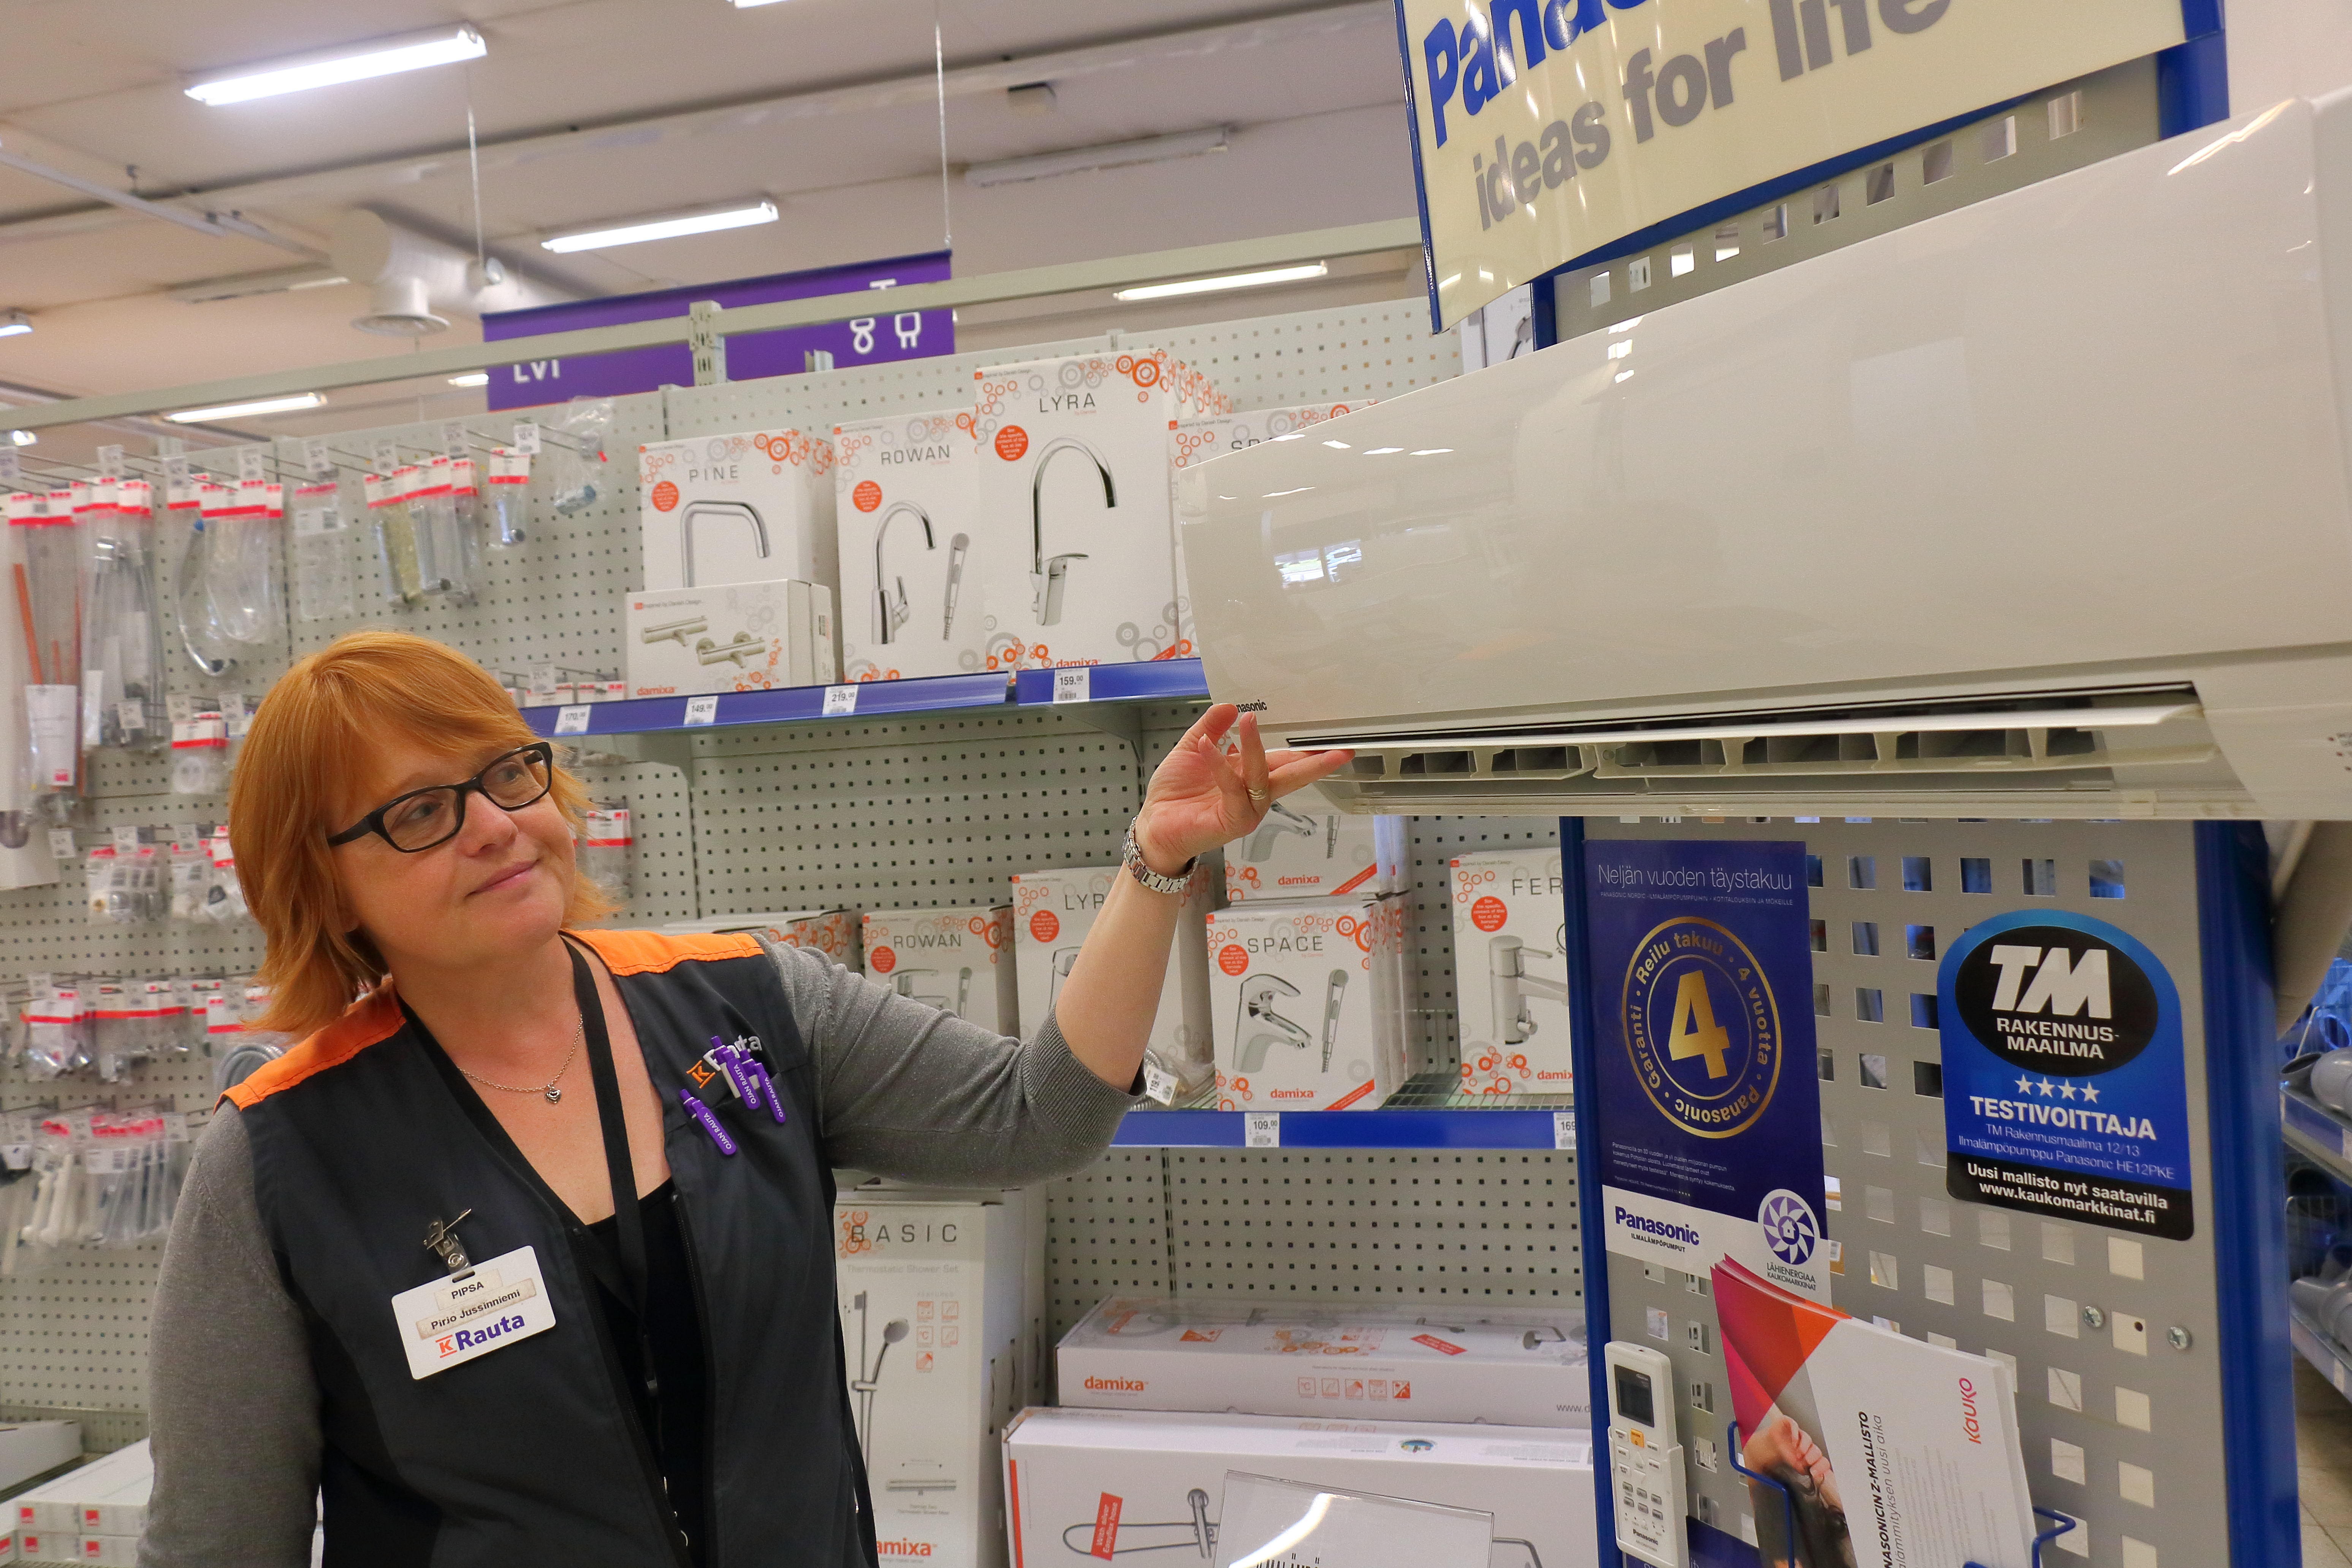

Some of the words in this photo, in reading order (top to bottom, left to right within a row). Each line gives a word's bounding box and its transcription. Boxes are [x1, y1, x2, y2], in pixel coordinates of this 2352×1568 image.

[1424, 0, 1647, 149] Pana
[1474, 100, 1610, 231] ideas
[1623, 26, 1745, 145] for
[1039, 393, 1095, 413] LYRA
[881, 444, 949, 466] ROWAN
[689, 465, 739, 483] PINE
[1056, 657, 1098, 668] damixa
[637, 686, 675, 695] damixa
[1236, 699, 1267, 713] nasonic
[1278, 874, 1320, 885] damixa
[1598, 864, 1643, 890] Neljän
[1647, 867, 1705, 887] vuoden
[1710, 868, 1792, 892] täystakuu
[1065, 893, 1105, 911] LYR
[893, 934, 961, 949] ROWAN
[1248, 936, 1323, 953] SPACE
[1636, 941, 1671, 984] Reilu
[1674, 931, 1722, 956] takuu
[1990, 944, 2112, 1019] TM
[1668, 970, 1730, 1079] 4
[1738, 968, 1750, 981] 4
[1749, 987, 1771, 1065] vuotta
[1996, 1017, 2119, 1042] RAKENNUS-
[1630, 1004, 1660, 1088] Garanti
[2007, 1036, 2104, 1060] MAAILMA
[733, 1064, 748, 1086] RAUTA
[1537, 1070, 1573, 1080] damix
[745, 1087, 756, 1104] OJAN
[765, 1077, 776, 1099] RAUTA
[1270, 1088, 1314, 1098] damixa
[773, 1099, 783, 1117] OJAN
[1674, 1084, 1760, 1123] Panasonic
[703, 1113, 720, 1133] RAUTA
[1970, 1096, 2156, 1140] TESTIVOITTAJA
[717, 1132, 732, 1149] OJAN
[1986, 1123, 2002, 1136] TM
[2005, 1128, 2102, 1152] Rakennusmaailma
[2107, 1142, 2140, 1157] 12/13
[1959, 1135, 2053, 1161] Ilmalämpöpumppu
[2056, 1151, 2113, 1170] Panasonic
[2117, 1160, 2175, 1180] HE12PKE
[1967, 1163, 1998, 1180] Uusi
[2003, 1169, 2059, 1191] mallisto
[2064, 1182, 2087, 1196] nyt
[2092, 1186, 2168, 1210] saatavilla
[1980, 1182, 2156, 1224] www.kaukomarkkinat.fi
[852, 1224, 957, 1243] BASIC
[1615, 1206, 1699, 1245] Panasonic
[1631, 1233, 1685, 1253] ILMALÄMPÖPUMPUT
[1767, 1262, 1816, 1283] LÄHIENERGIAA
[1768, 1272, 1816, 1291] KAUKOMARKKINAT
[451, 1281, 485, 1299] PIPSA
[431, 1315, 457, 1330] Pirjo
[460, 1290, 521, 1318] Jussinniemi
[1084, 1376, 1144, 1391] damixa
[1873, 1415, 1885, 1444] aika
[1859, 1411, 1883, 1493] Z-MALLISTO
[1880, 1448, 1891, 1475] uusi
[876, 1538, 931, 1556] amixa
[1633, 1528, 1658, 1545] Panasonic
